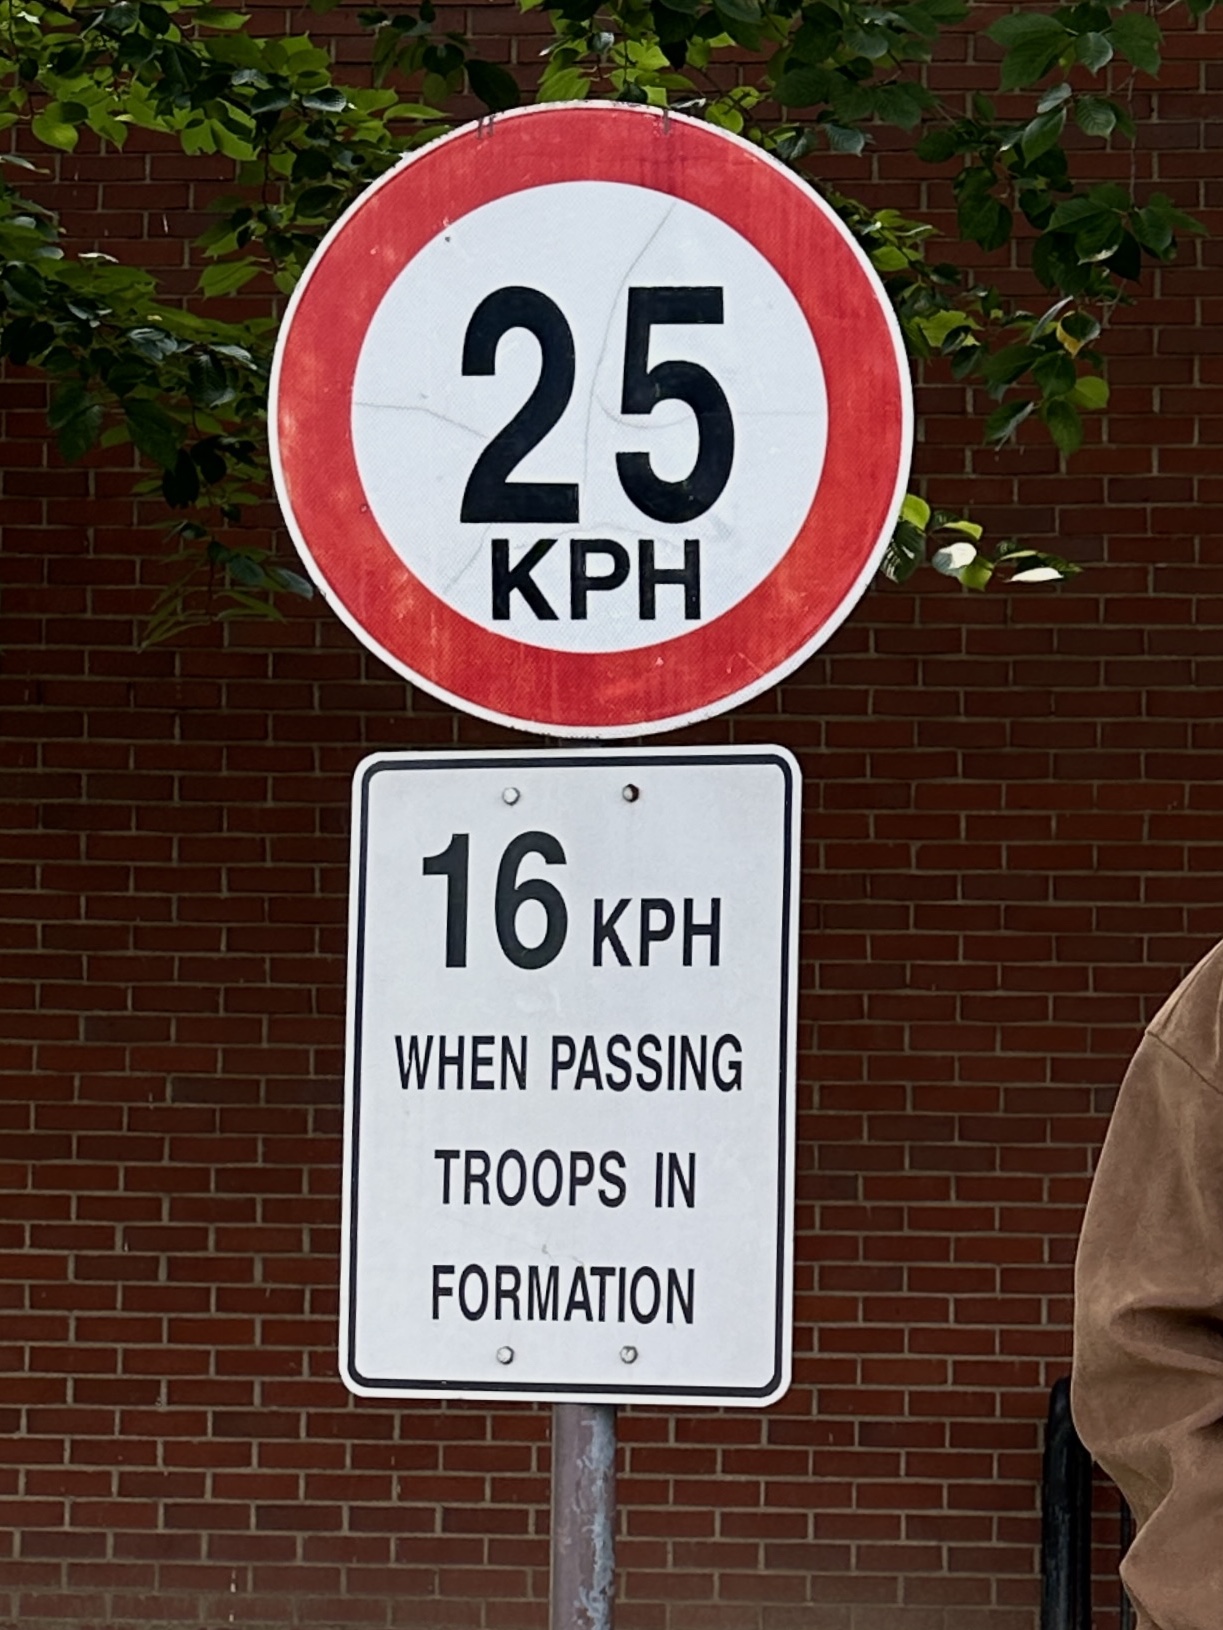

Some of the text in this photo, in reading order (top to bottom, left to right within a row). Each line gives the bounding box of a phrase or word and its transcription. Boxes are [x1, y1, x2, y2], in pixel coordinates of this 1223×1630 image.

[460, 285, 735, 524] 25
[491, 538, 701, 621] KPH
[422, 830, 721, 970] 16 KPH
[394, 1033, 743, 1092] WHEN PASSING
[434, 1148, 696, 1209] TROOPS IN
[432, 1263, 695, 1325] FORMATION
